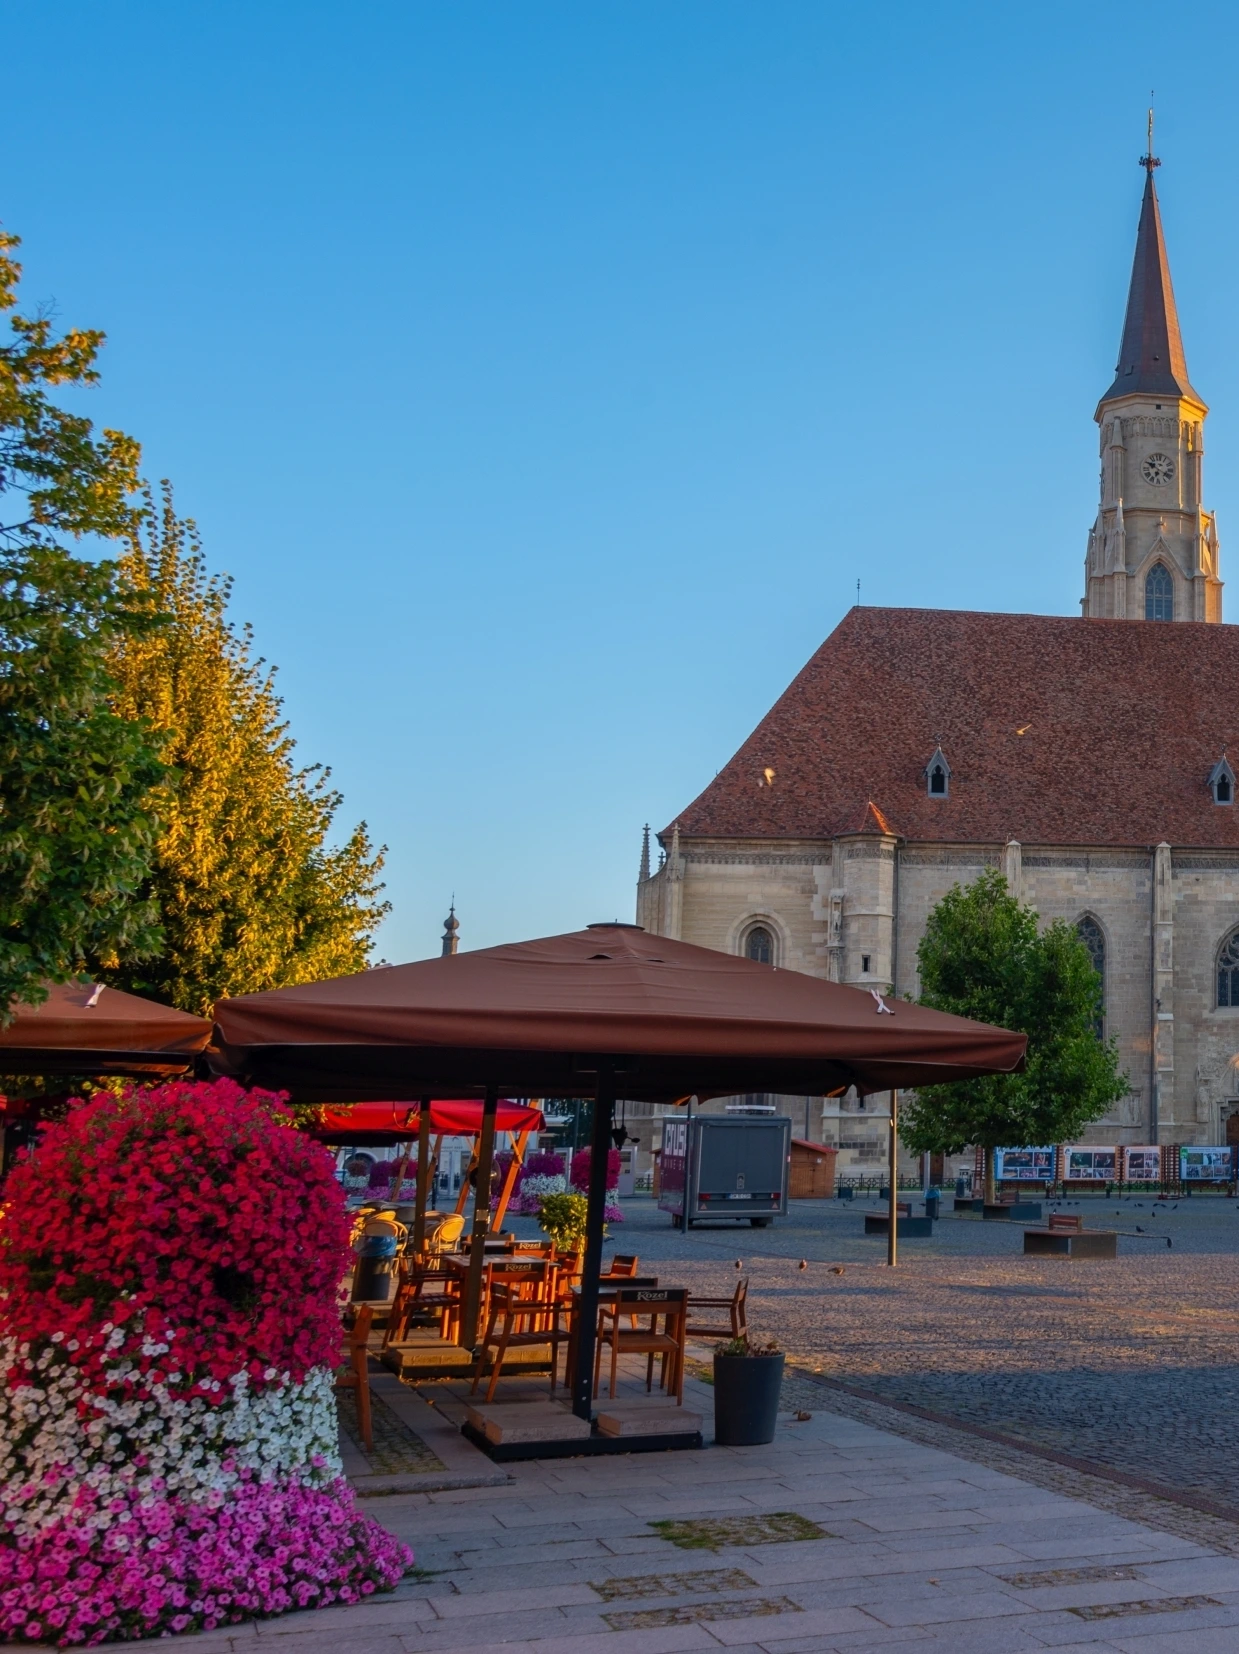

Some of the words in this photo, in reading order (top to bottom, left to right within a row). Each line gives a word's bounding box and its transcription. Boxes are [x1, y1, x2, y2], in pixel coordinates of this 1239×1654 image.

[519, 1242, 541, 1250] Kozel
[505, 1263, 532, 1272] Kozel
[637, 1291, 668, 1301] Kozel
